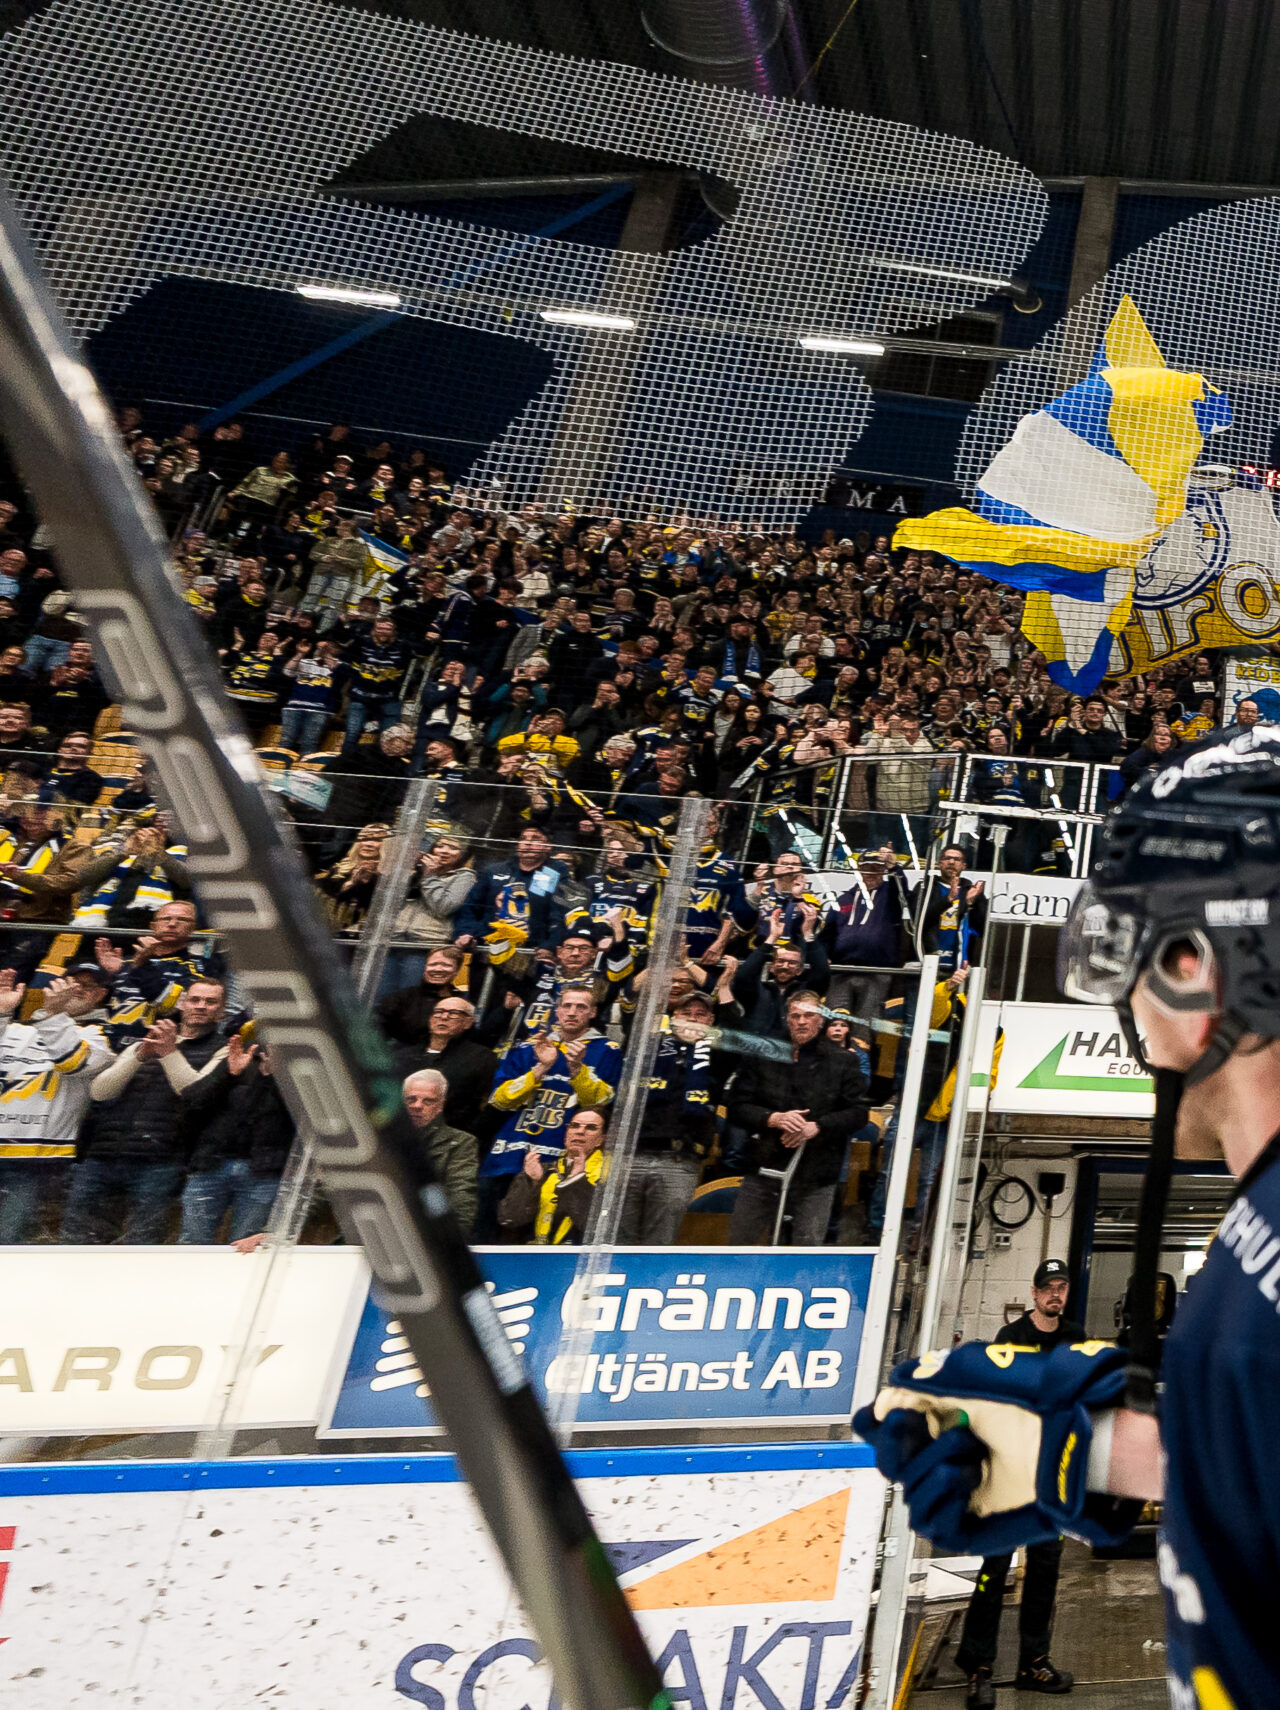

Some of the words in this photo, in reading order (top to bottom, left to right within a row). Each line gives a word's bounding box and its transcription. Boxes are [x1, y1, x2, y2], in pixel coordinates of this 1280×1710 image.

[1235, 663, 1269, 683] RED
[1107, 1062, 1152, 1076] EQU
[560, 1273, 852, 1333] Gränna
[760, 1349, 844, 1391] AB
[394, 1619, 865, 1710] SCAKT
